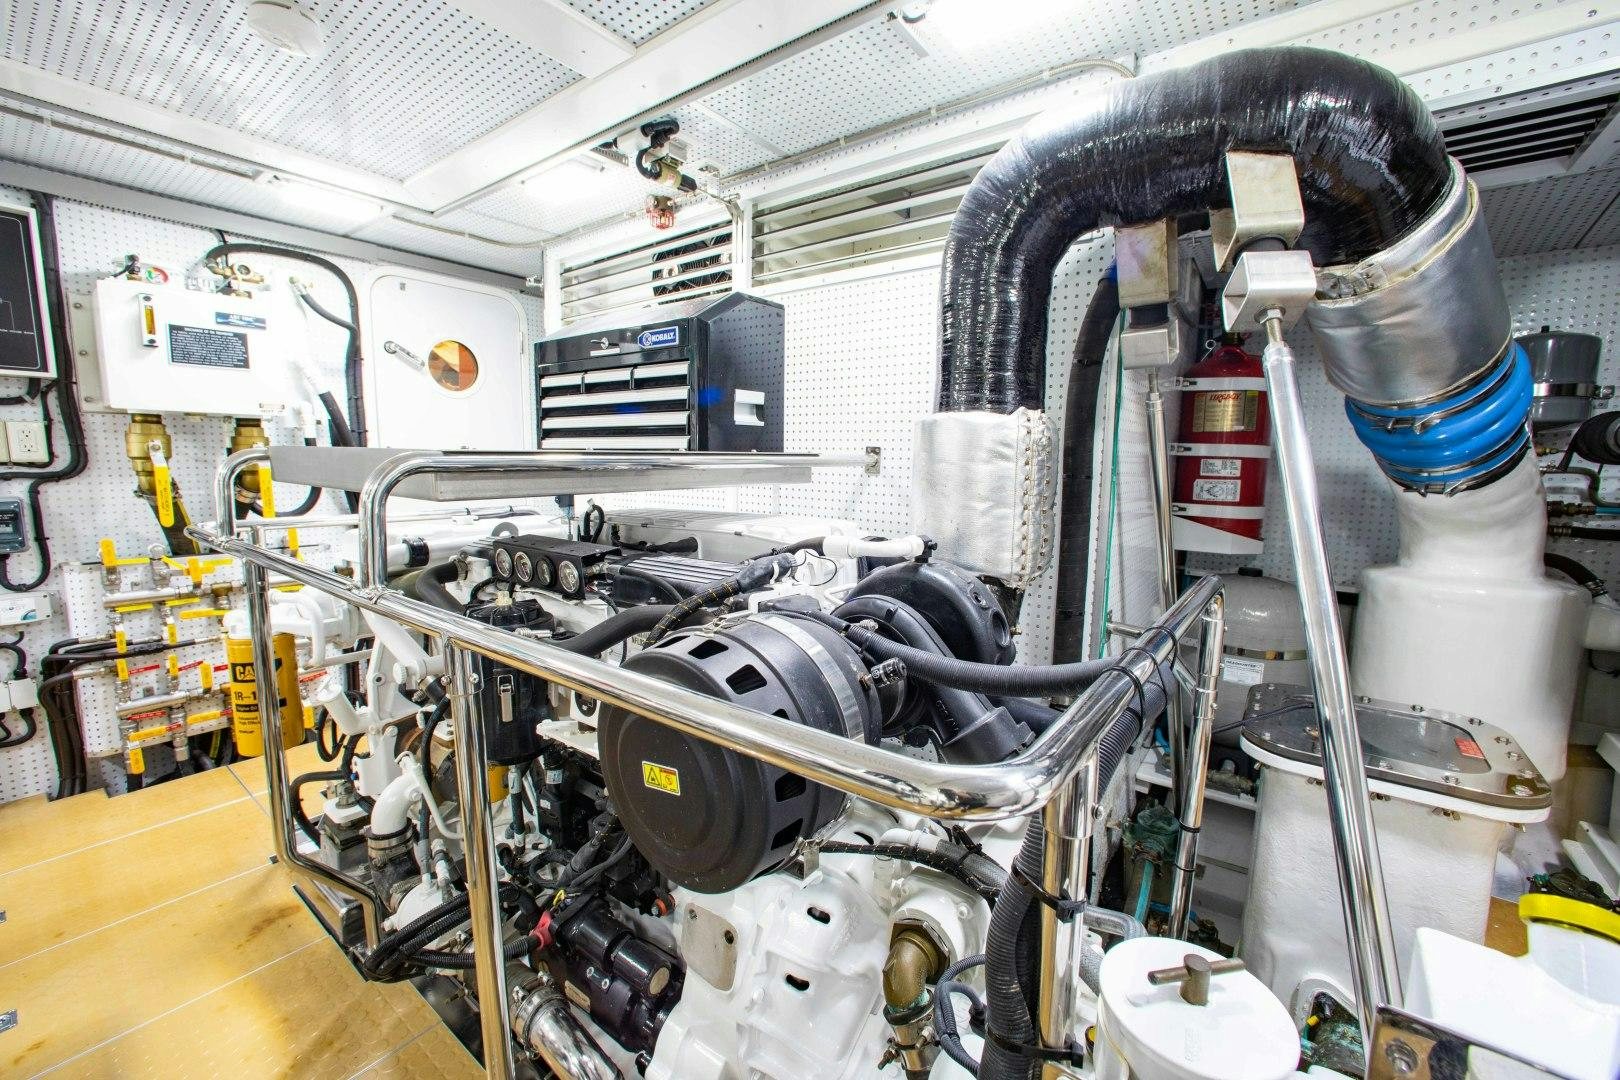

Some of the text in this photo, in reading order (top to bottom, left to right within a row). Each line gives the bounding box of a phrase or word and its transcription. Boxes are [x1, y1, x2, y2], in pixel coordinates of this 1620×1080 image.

[651, 332, 674, 342] KOBALT
[235, 666, 256, 680] CA
[234, 691, 257, 701] 1R-1
